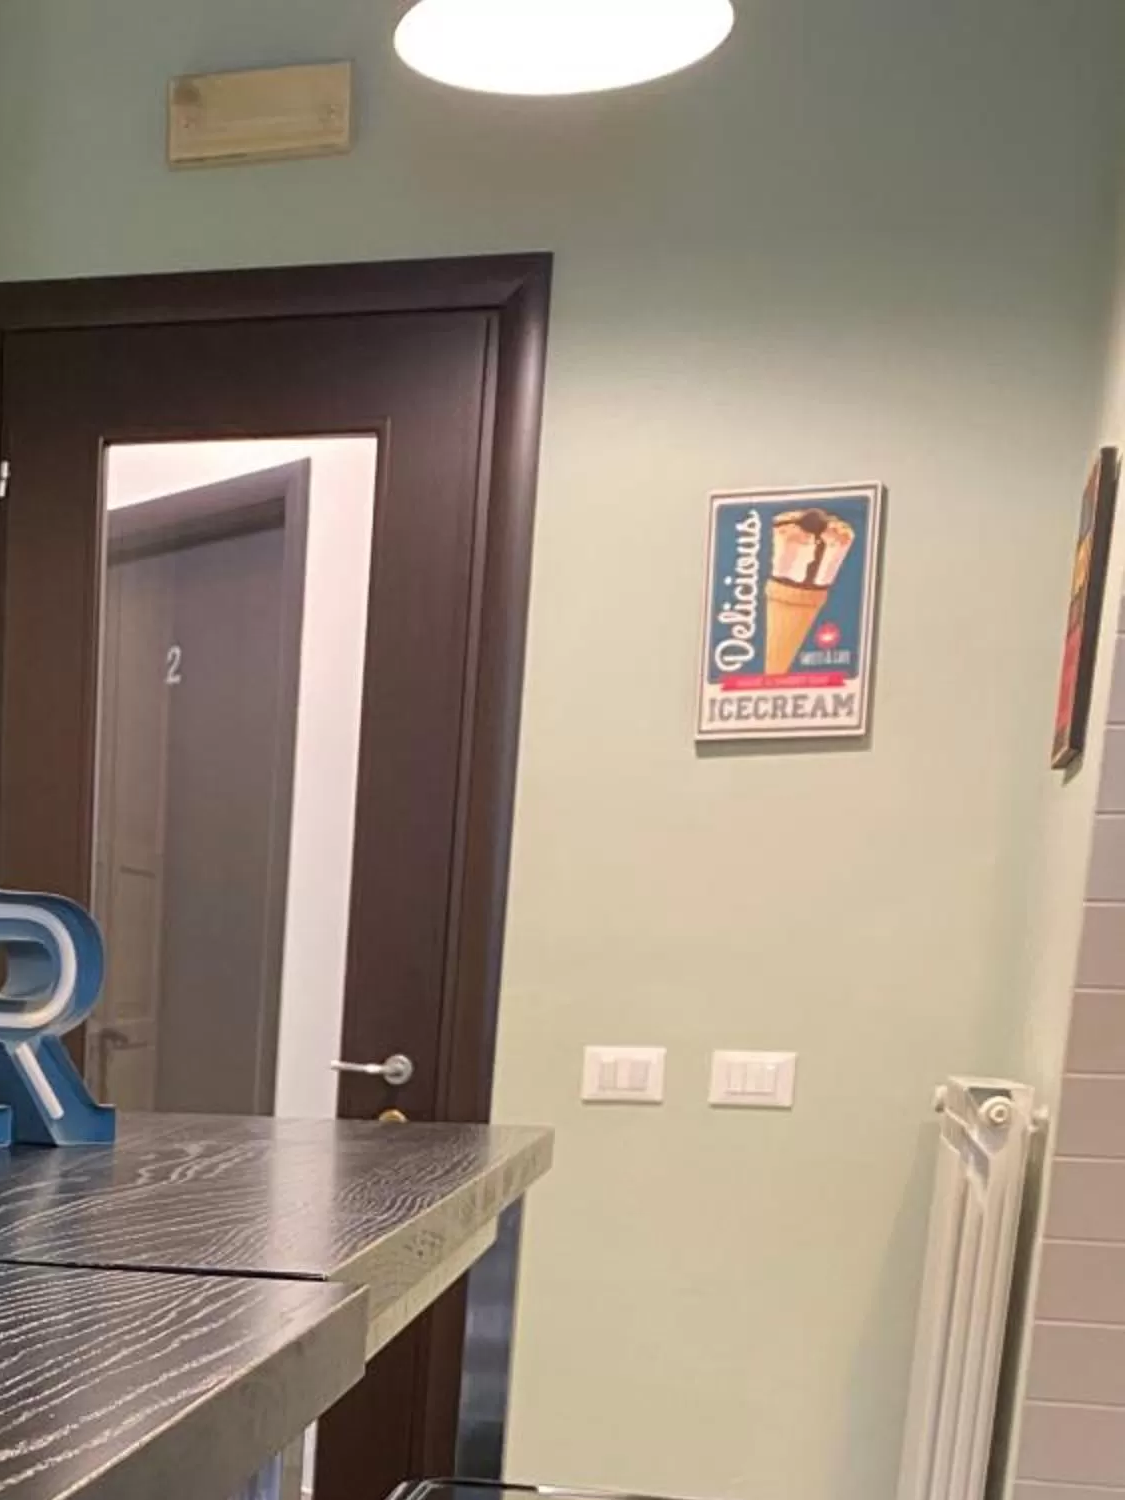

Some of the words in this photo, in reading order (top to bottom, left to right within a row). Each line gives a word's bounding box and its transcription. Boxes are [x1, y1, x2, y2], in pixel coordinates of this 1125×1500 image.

[715, 509, 762, 672] Delicious
[165, 646, 182, 684] 2
[709, 693, 855, 723] ICECREAM
